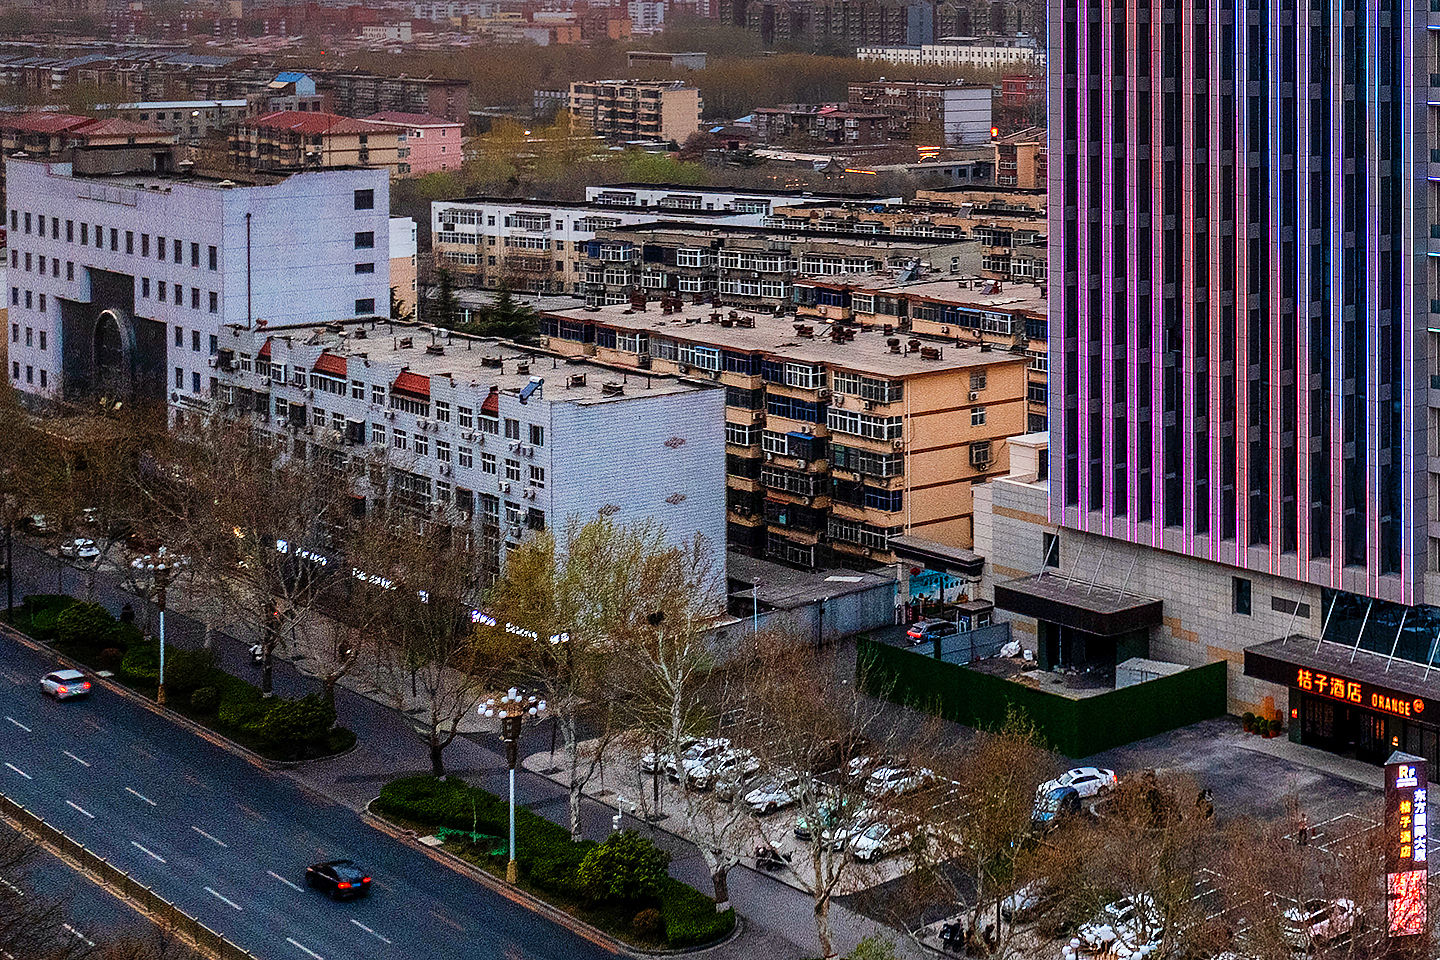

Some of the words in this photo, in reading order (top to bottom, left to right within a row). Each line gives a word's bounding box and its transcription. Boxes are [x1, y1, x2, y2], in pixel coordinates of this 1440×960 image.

[1297, 668, 1362, 703] 桔子酒店
[1371, 692, 1411, 717] ORANGE
